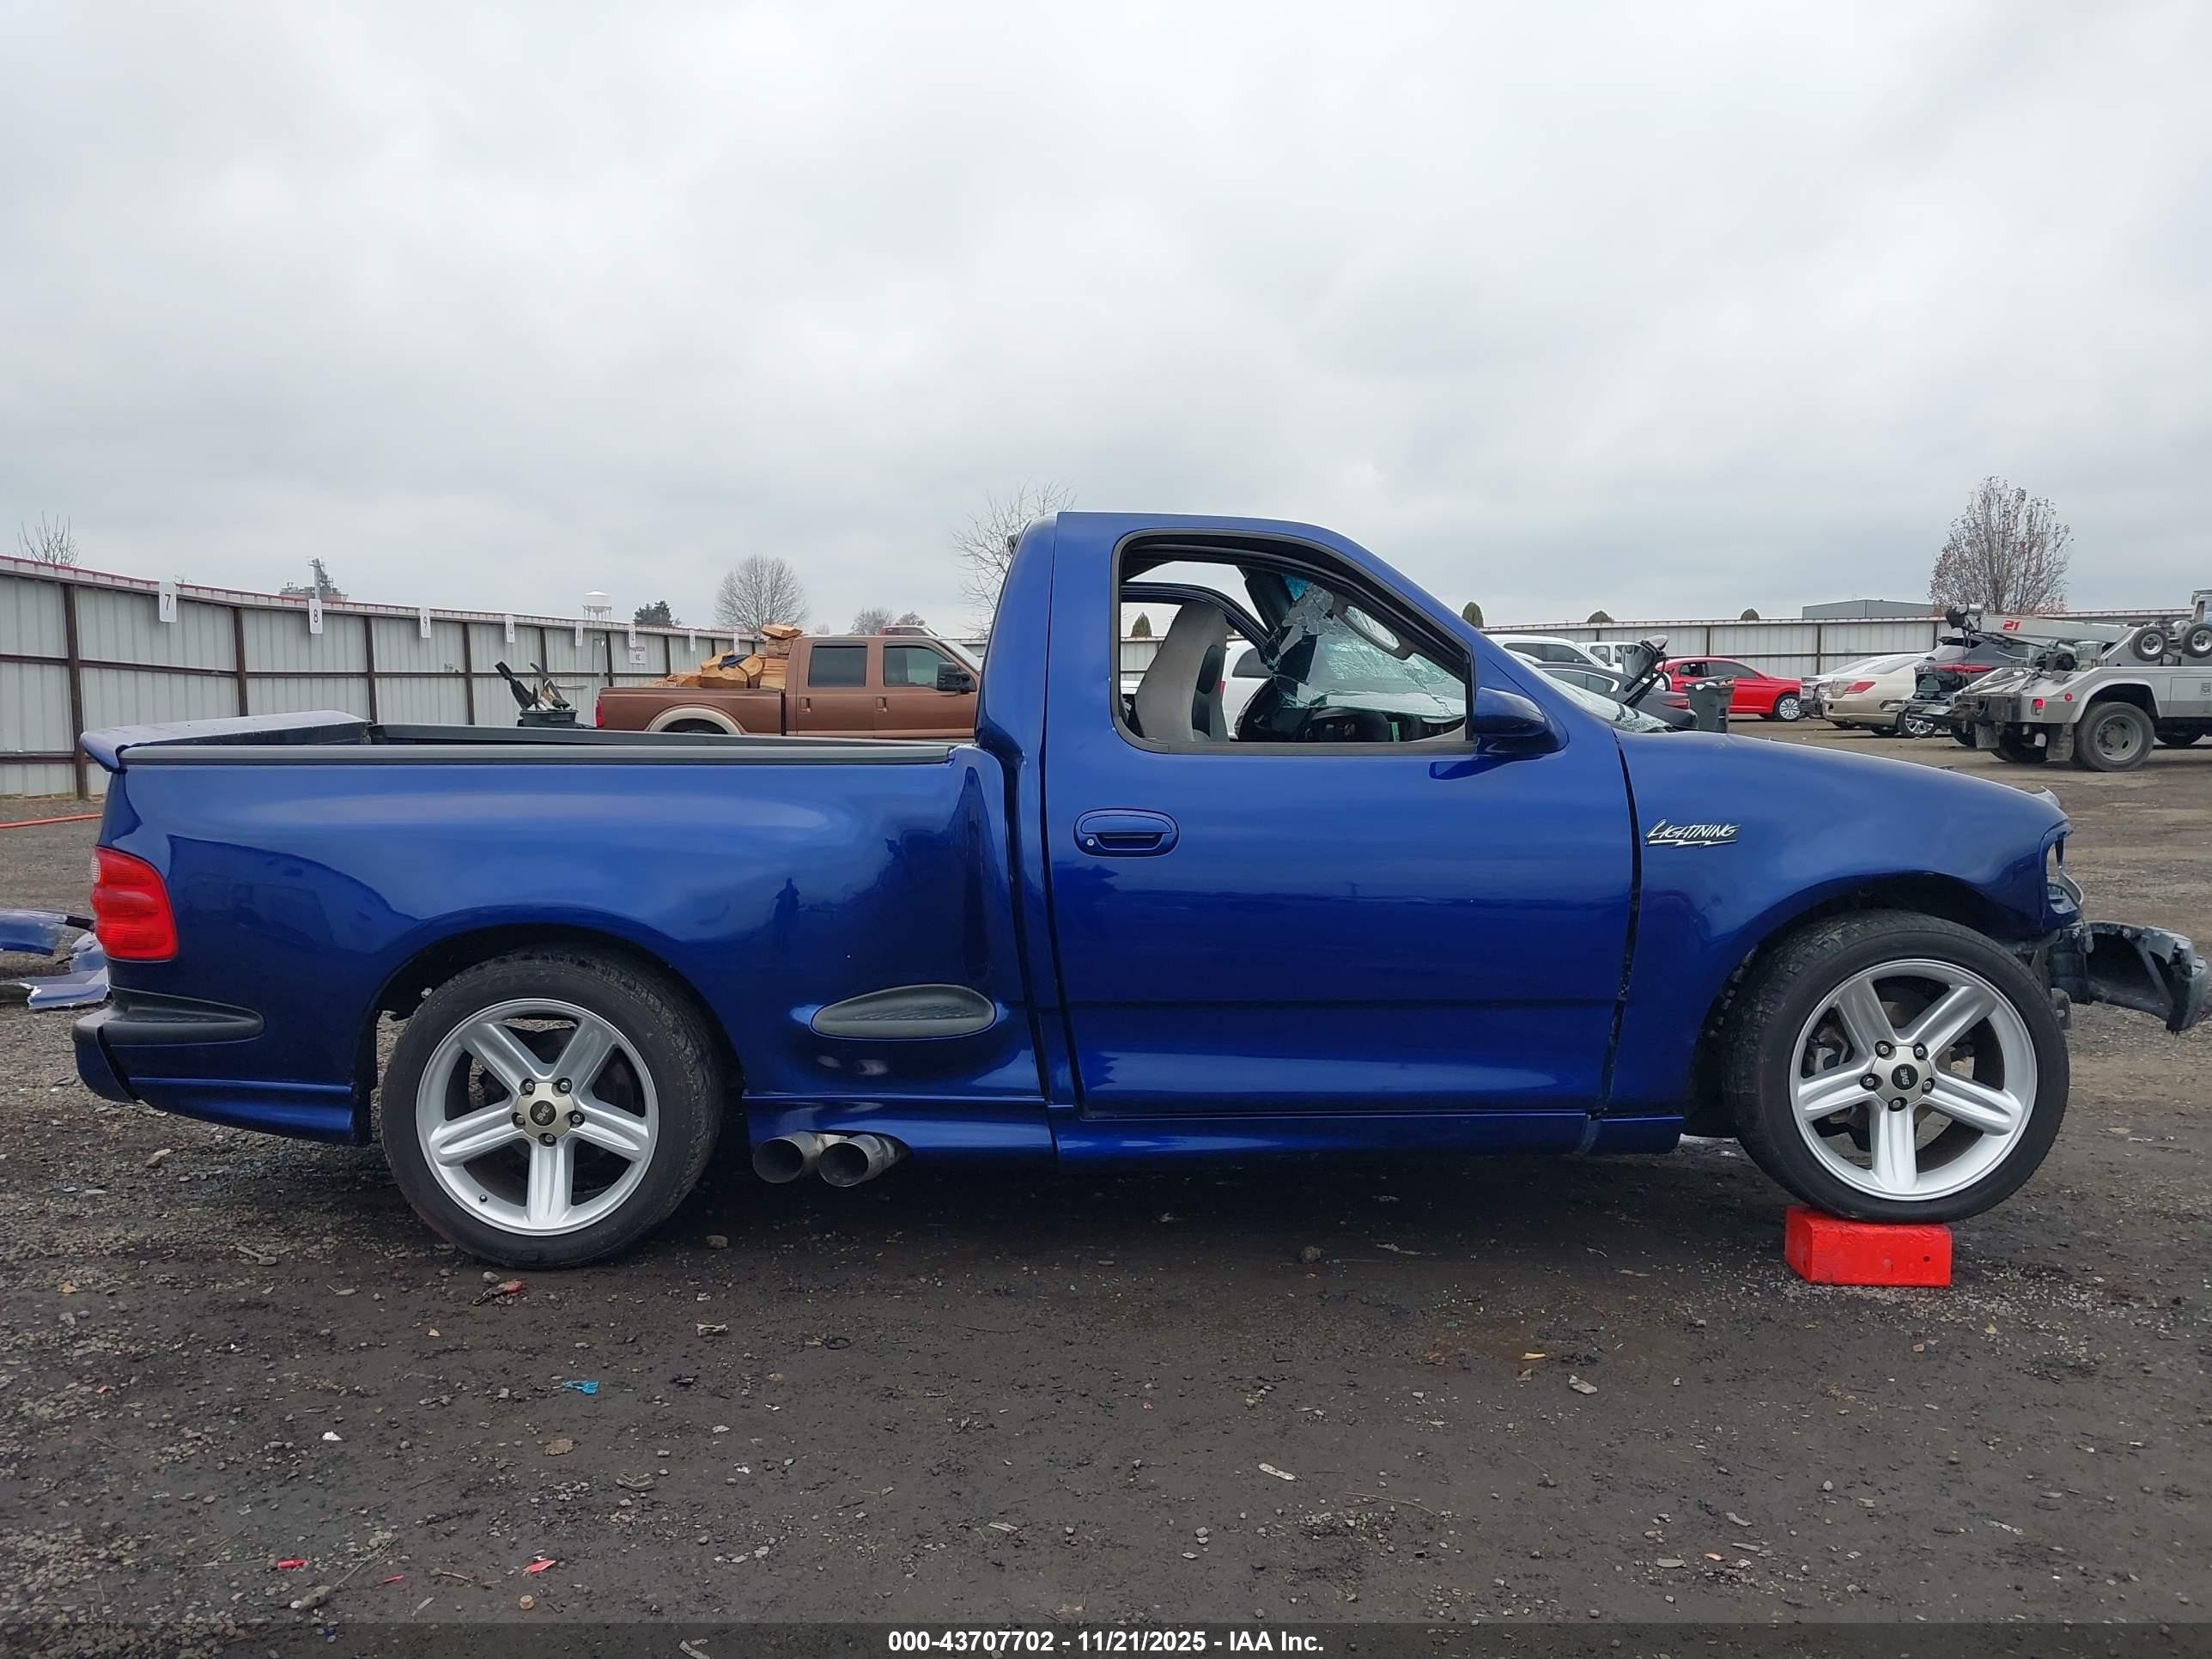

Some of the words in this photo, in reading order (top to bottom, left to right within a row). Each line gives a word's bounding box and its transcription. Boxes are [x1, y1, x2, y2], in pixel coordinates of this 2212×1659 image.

[164, 593, 171, 611] 7
[313, 609, 319, 623] 8
[422, 616, 428, 629] 9
[507, 623, 514, 635] 10
[2002, 620, 2020, 632] 21
[1645, 817, 1740, 839] LIGHTNING
[1899, 1067, 1910, 1085] SVE
[536, 1104, 550, 1122] SVE
